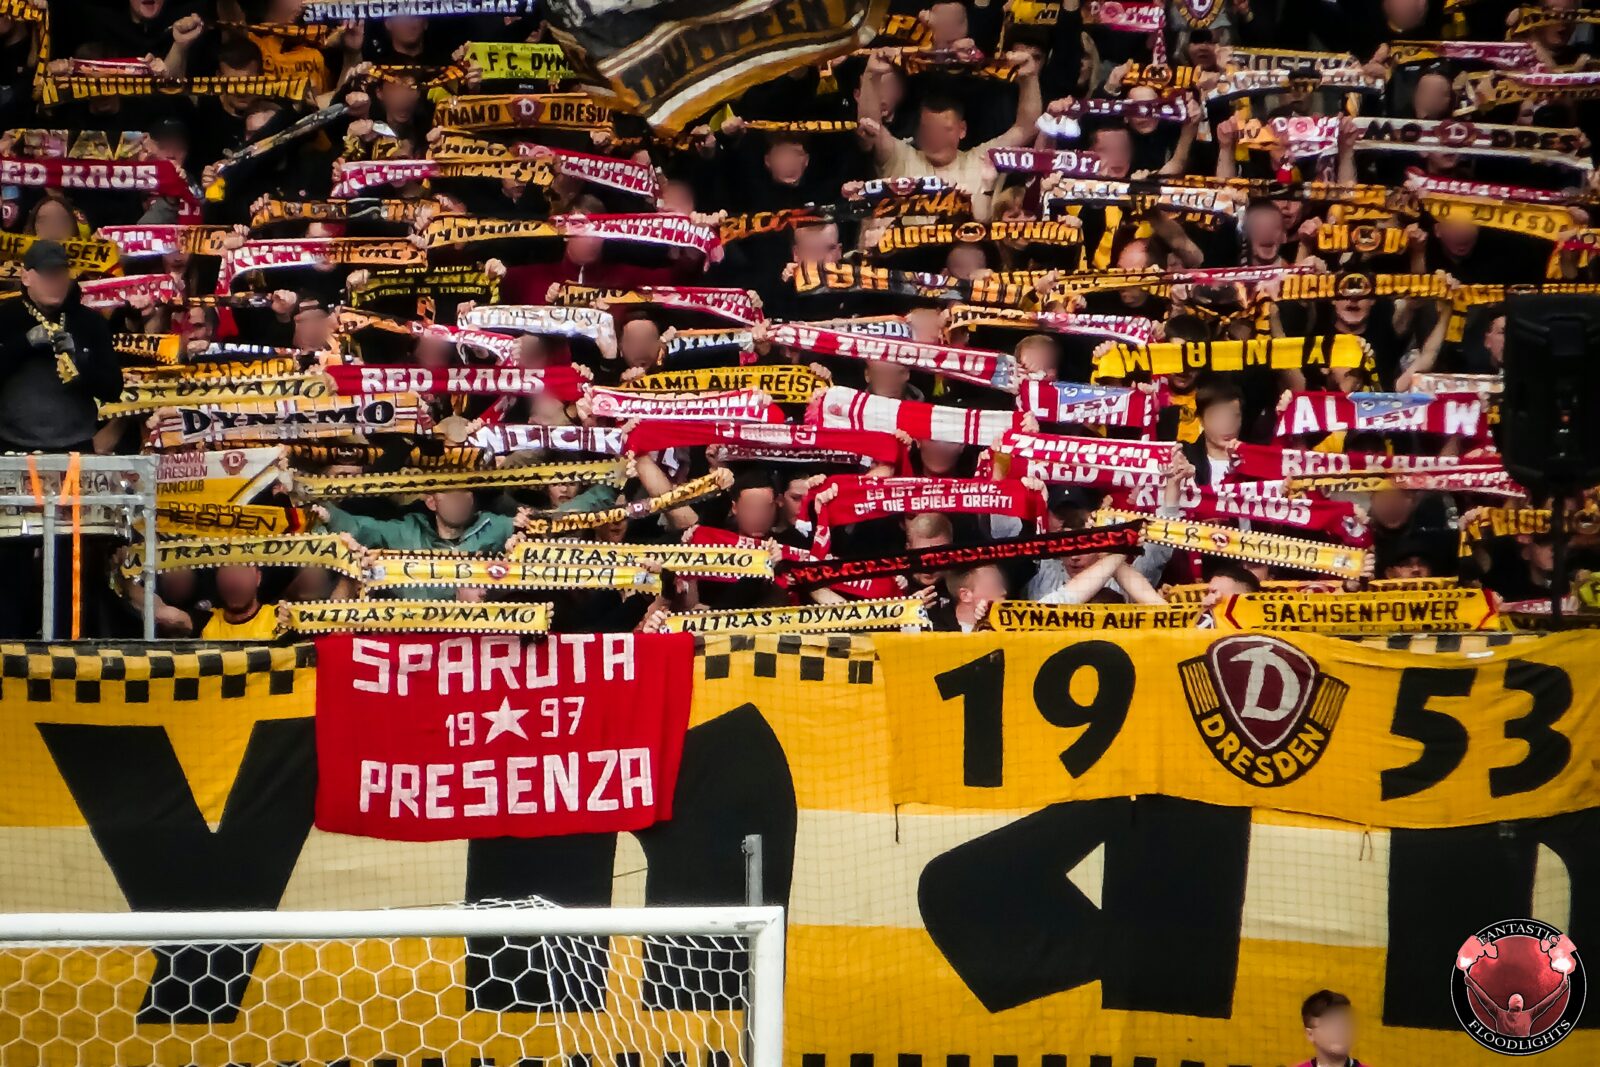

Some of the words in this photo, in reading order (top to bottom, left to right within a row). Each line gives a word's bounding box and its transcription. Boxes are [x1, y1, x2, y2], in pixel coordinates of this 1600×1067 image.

[1, 160, 48, 188] ED
[61, 163, 158, 189] KAOS
[64, 242, 112, 264] SEN
[836, 335, 986, 372] ZWICKAU
[176, 380, 327, 399] DYNAMO
[361, 368, 433, 393] RED
[447, 367, 546, 393] KAOS
[177, 401, 396, 437] DYNAMO
[1027, 459, 1100, 483] RED
[1282, 449, 1350, 475] RED
[911, 495, 957, 510] SPIELE
[123, 541, 233, 568] UTRAS
[643, 550, 753, 568] DYNAMO
[299, 607, 395, 624] ULTRAS
[422, 607, 536, 625] DYNAMO
[682, 610, 773, 632] ULTRAS
[798, 603, 904, 624] DYNAMO
[999, 609, 1095, 629] DYNAMO
[1102, 610, 1146, 629] AUF
[1262, 600, 1460, 623] SACHSENPOWER
[352, 632, 636, 697] SPARUTA
[445, 711, 476, 747] 19
[541, 696, 585, 738] 97
[936, 640, 1136, 788] 19
[1381, 659, 1573, 801] 53
[1200, 712, 1326, 785] DRESDEN
[359, 747, 654, 820] PRESENZA
